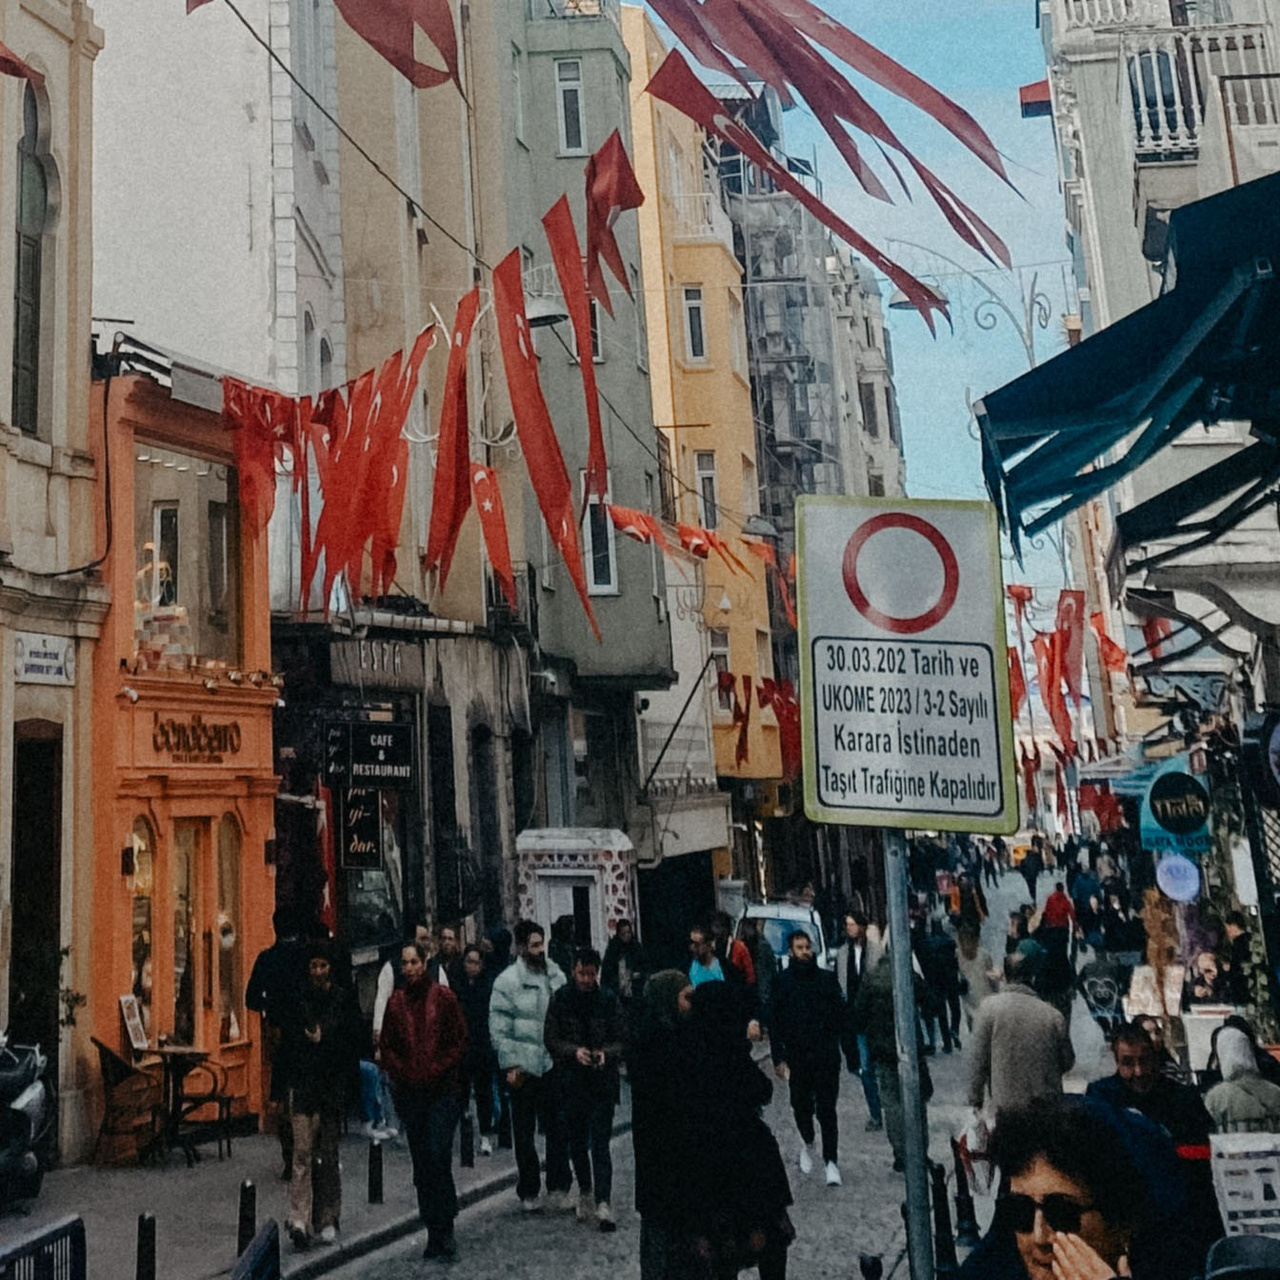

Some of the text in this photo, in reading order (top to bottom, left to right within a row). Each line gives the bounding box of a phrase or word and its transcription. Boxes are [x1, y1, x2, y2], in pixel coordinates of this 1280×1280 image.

[827, 645, 980, 678] 30.03.202 Tarih ve
[822, 684, 875, 713] UKOME
[880, 687, 912, 715] 2023
[924, 690, 945, 717] 3-2
[949, 690, 988, 725] Sayılı
[370, 734, 393, 747] CAFE
[833, 720, 981, 758] Karara İstinaden
[352, 763, 411, 778] RESTAURANT
[822, 765, 997, 806] Taşıt Trafiğine Kapalıdır
